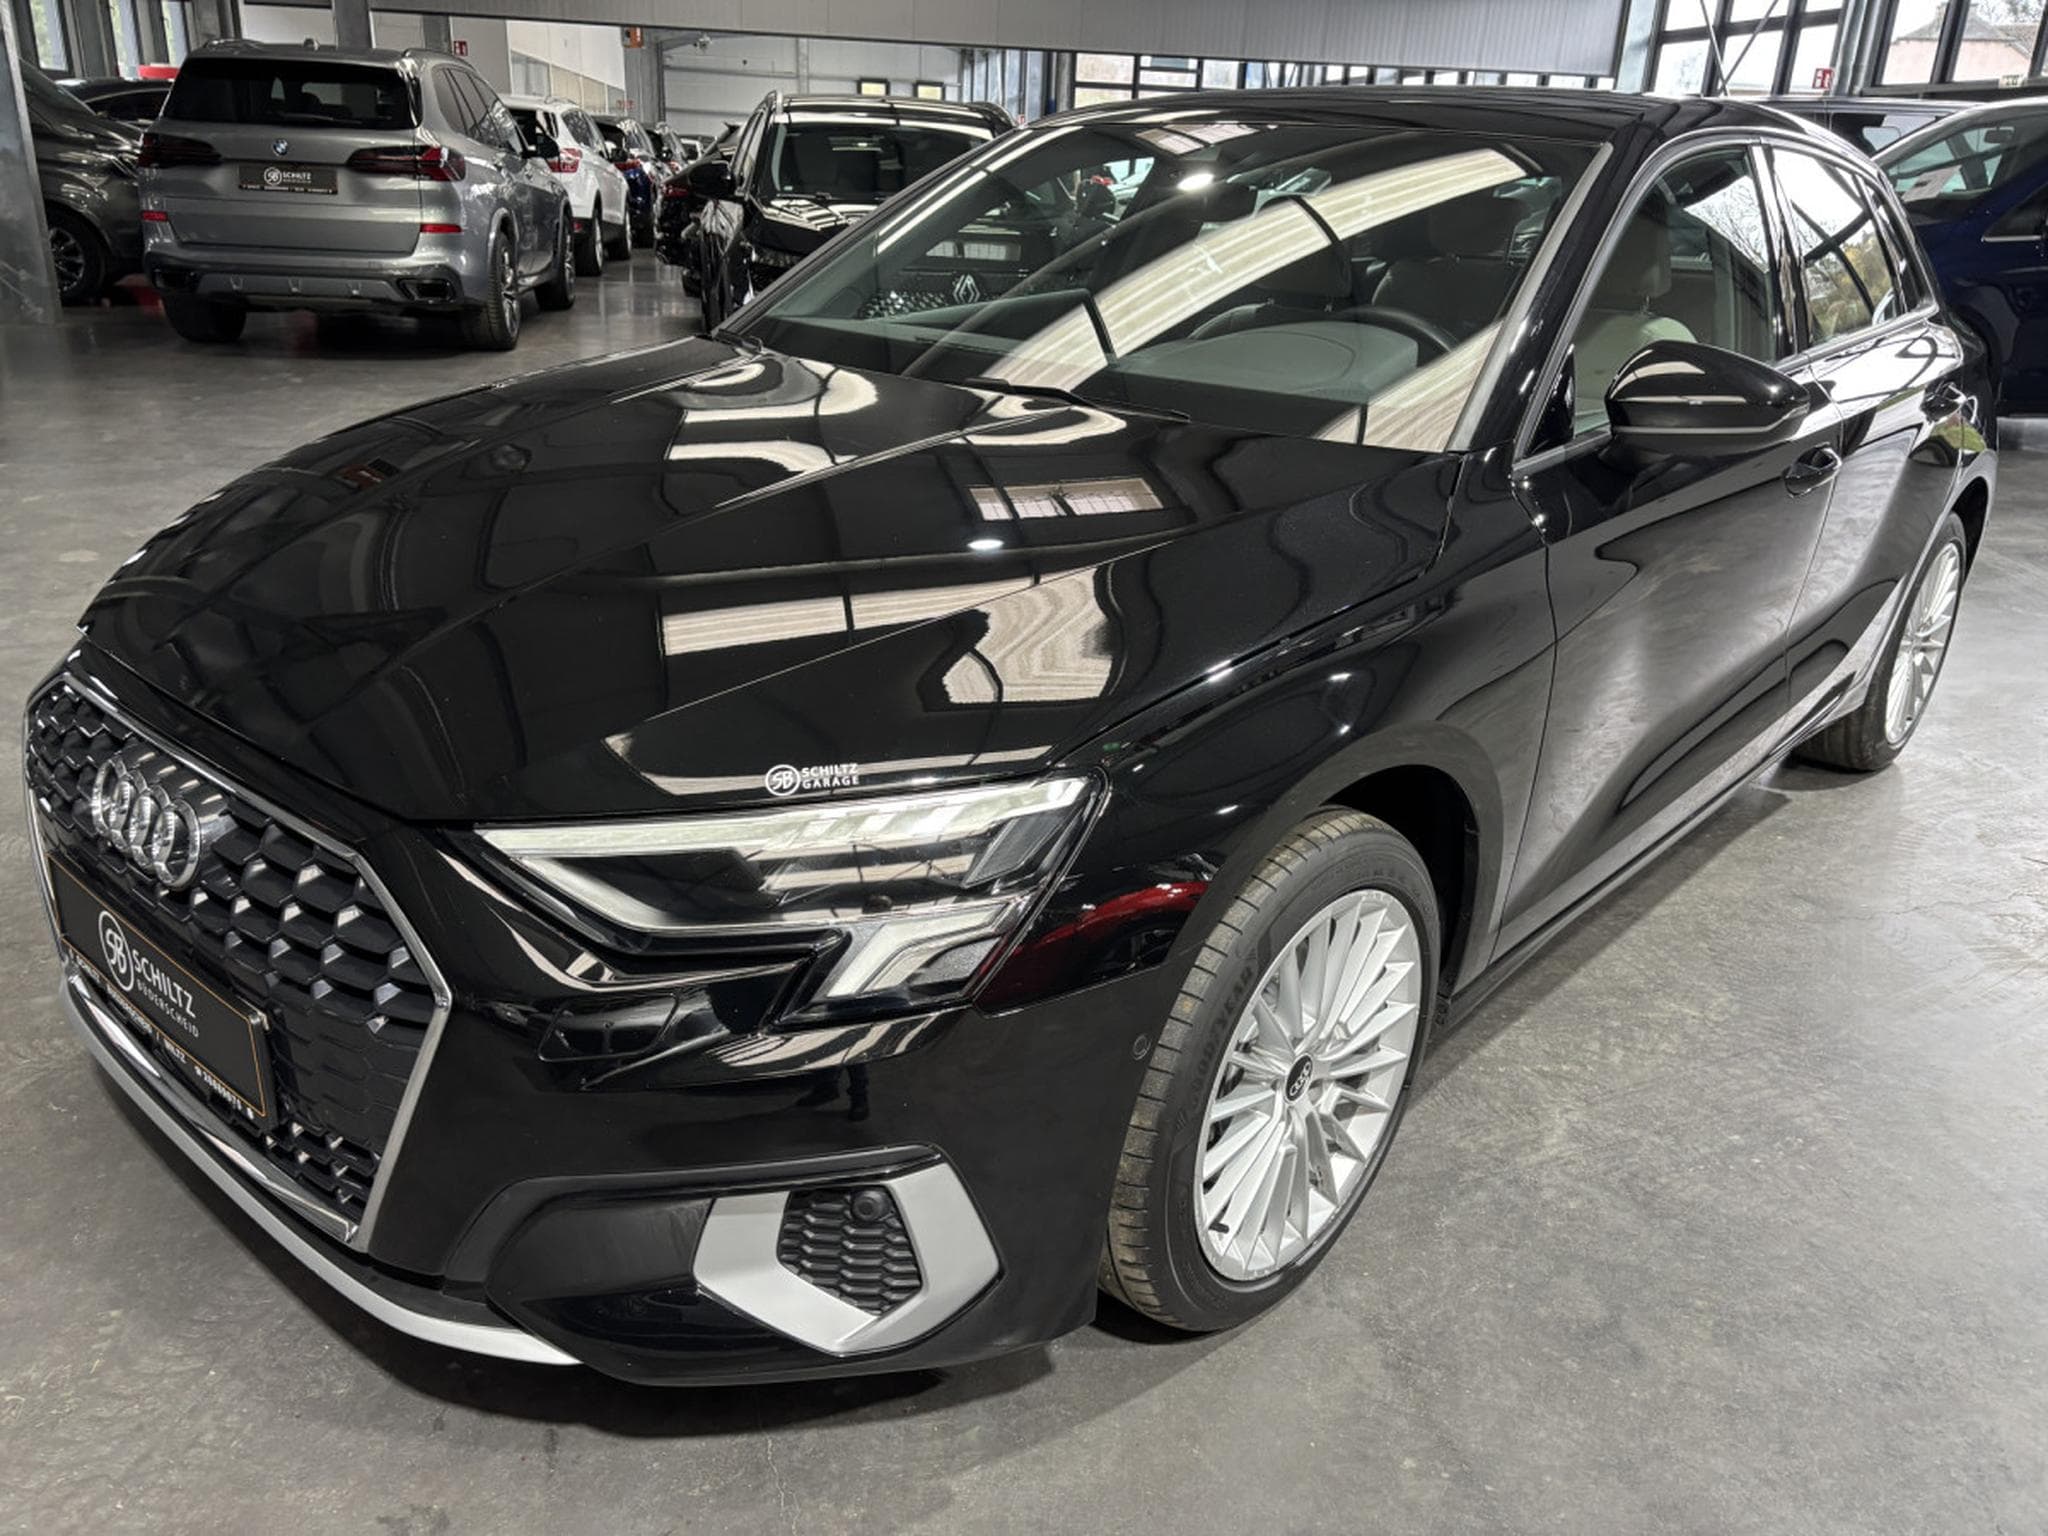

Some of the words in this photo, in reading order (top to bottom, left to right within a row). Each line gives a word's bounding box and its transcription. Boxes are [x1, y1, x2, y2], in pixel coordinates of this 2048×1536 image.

[801, 763, 859, 778] SCHILTZ
[802, 775, 859, 789] GARAGE
[132, 949, 197, 1018] SCHILTZ
